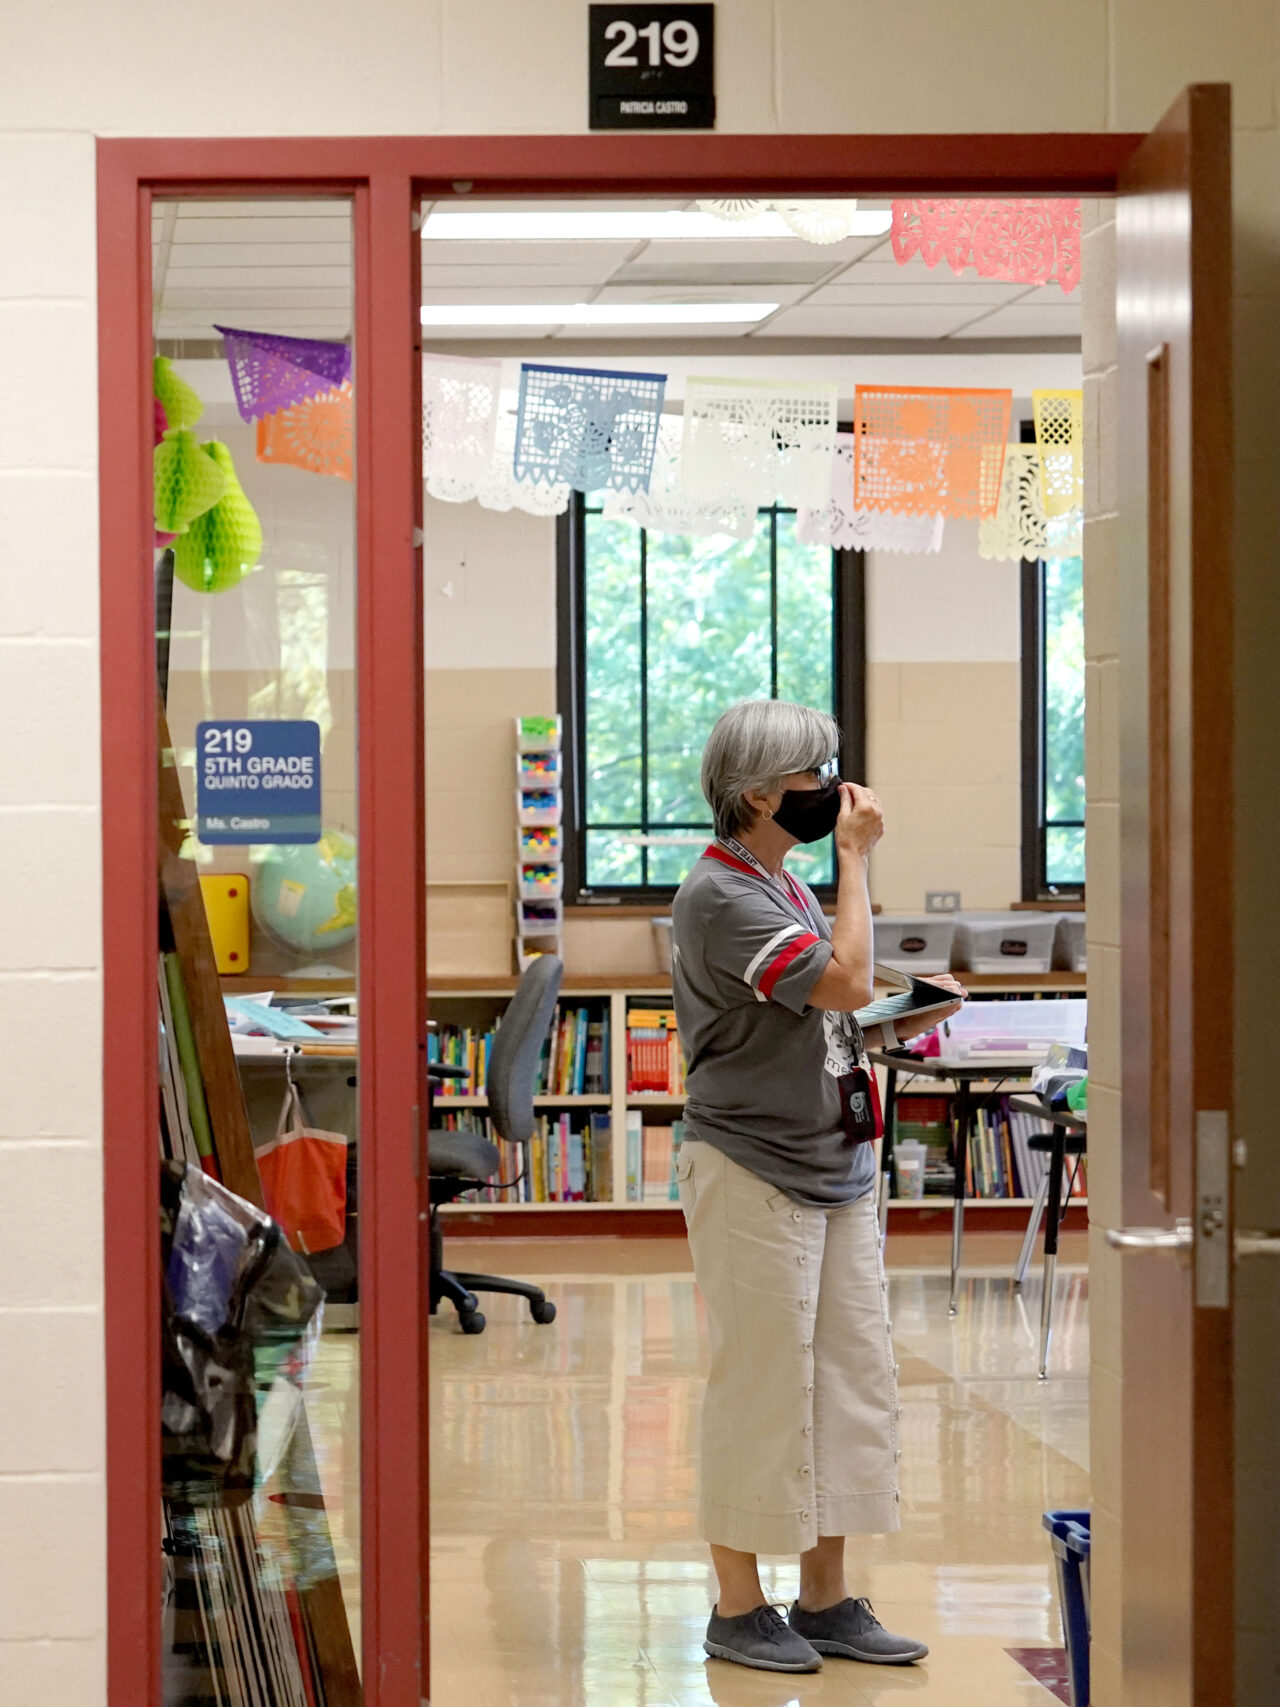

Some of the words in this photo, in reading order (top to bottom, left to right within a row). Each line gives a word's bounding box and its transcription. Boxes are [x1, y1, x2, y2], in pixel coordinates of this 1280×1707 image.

[604, 20, 700, 67] 219
[620, 101, 654, 114] PATRICIA
[655, 101, 688, 114] CASTRO
[204, 728, 253, 753] 219
[204, 757, 242, 774] 5TH
[247, 757, 314, 774] GRADE
[204, 775, 259, 790] QUINTO
[262, 775, 313, 789] GRADO
[230, 817, 270, 830] Castro
